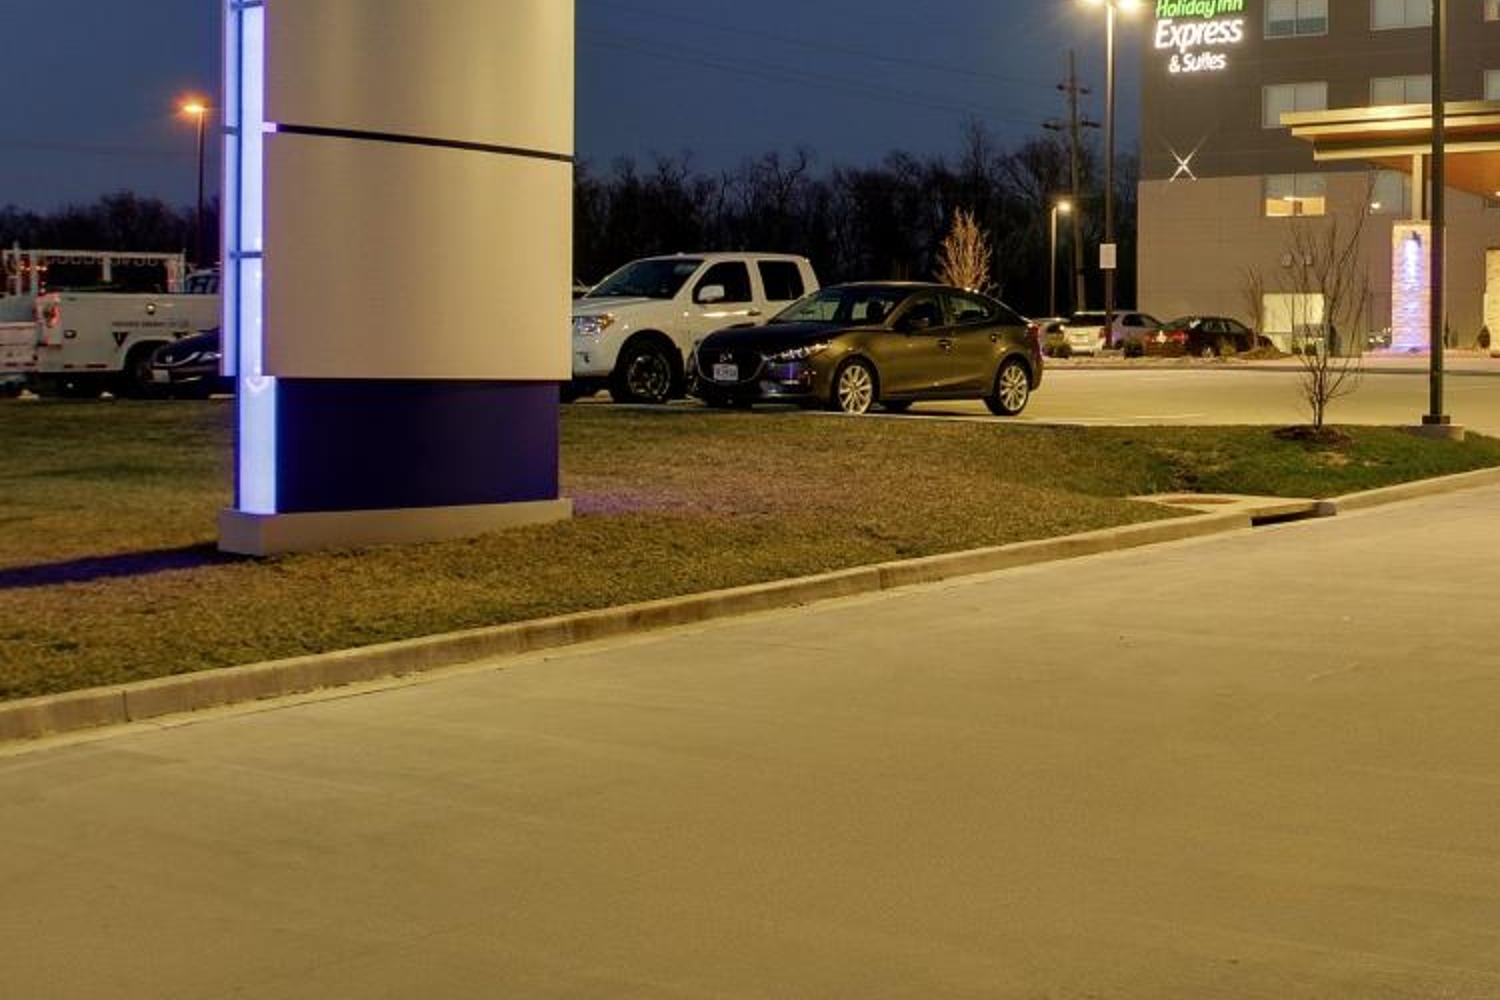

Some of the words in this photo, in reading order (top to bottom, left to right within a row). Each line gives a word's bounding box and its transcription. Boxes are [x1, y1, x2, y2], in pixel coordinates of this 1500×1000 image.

[1153, 17, 1244, 53] Express
[1168, 53, 1181, 74] &
[1181, 51, 1228, 73] Suites
